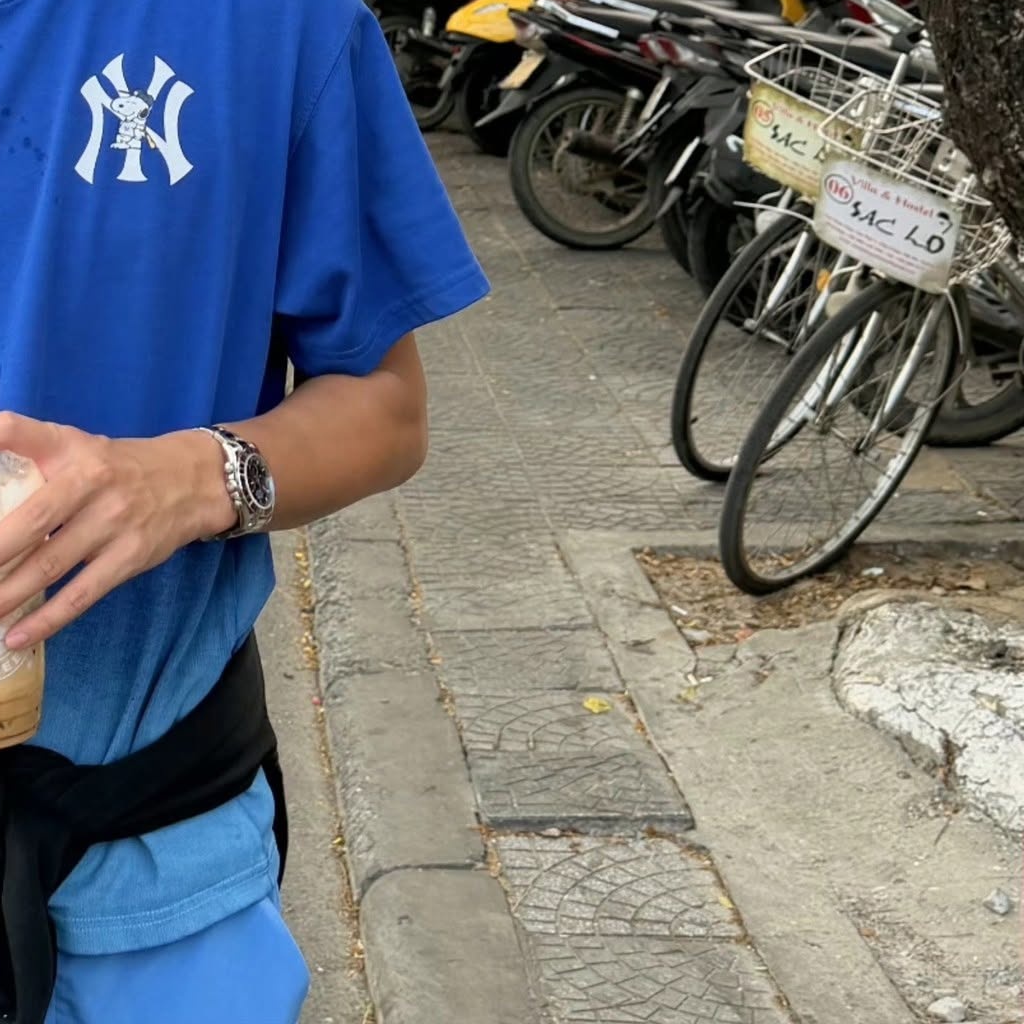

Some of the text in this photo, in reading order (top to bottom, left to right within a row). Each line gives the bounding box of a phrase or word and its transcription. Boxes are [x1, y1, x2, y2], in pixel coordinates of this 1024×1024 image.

[828, 179, 850, 200] 06
[851, 175, 878, 195] Villa
[881, 190, 891, 201] &
[850, 201, 896, 236] SAC
[904, 225, 946, 255] LO
